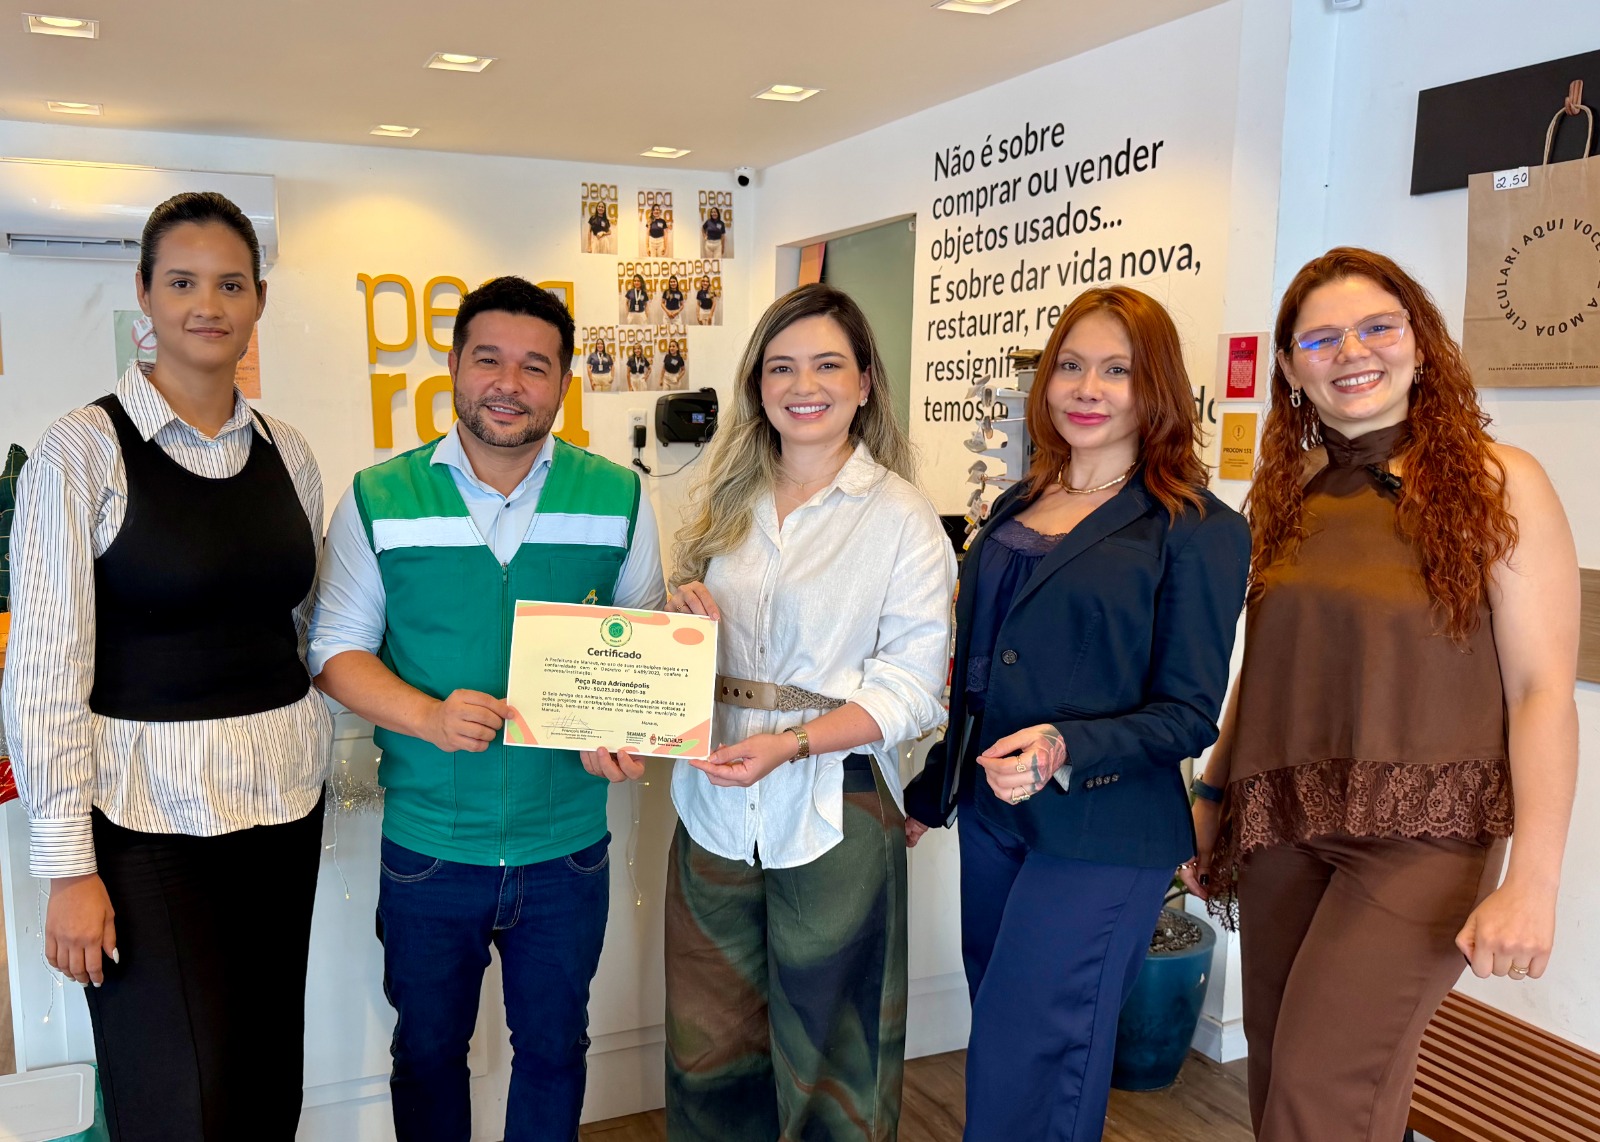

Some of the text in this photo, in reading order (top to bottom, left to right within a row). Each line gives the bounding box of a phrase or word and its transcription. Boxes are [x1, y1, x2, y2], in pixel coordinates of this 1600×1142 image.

[934, 121, 1065, 182] Não é sobre
[932, 138, 1164, 220] comprar ou vender
[930, 201, 1122, 263] objetos usados...
[1522, 218, 1564, 246] AQUI
[929, 242, 1202, 305] É sobre dar vida nova,
[1496, 247, 1527, 331] CIRCULAR!
[357, 273, 583, 364] pe
[927, 308, 1029, 341] restaurar,
[1535, 312, 1584, 337] MODA
[924, 395, 985, 422] temos
[587, 647, 642, 660] Certificado
[574, 678, 590, 686] Peça
[608, 680, 650, 689] Adrianópolis
